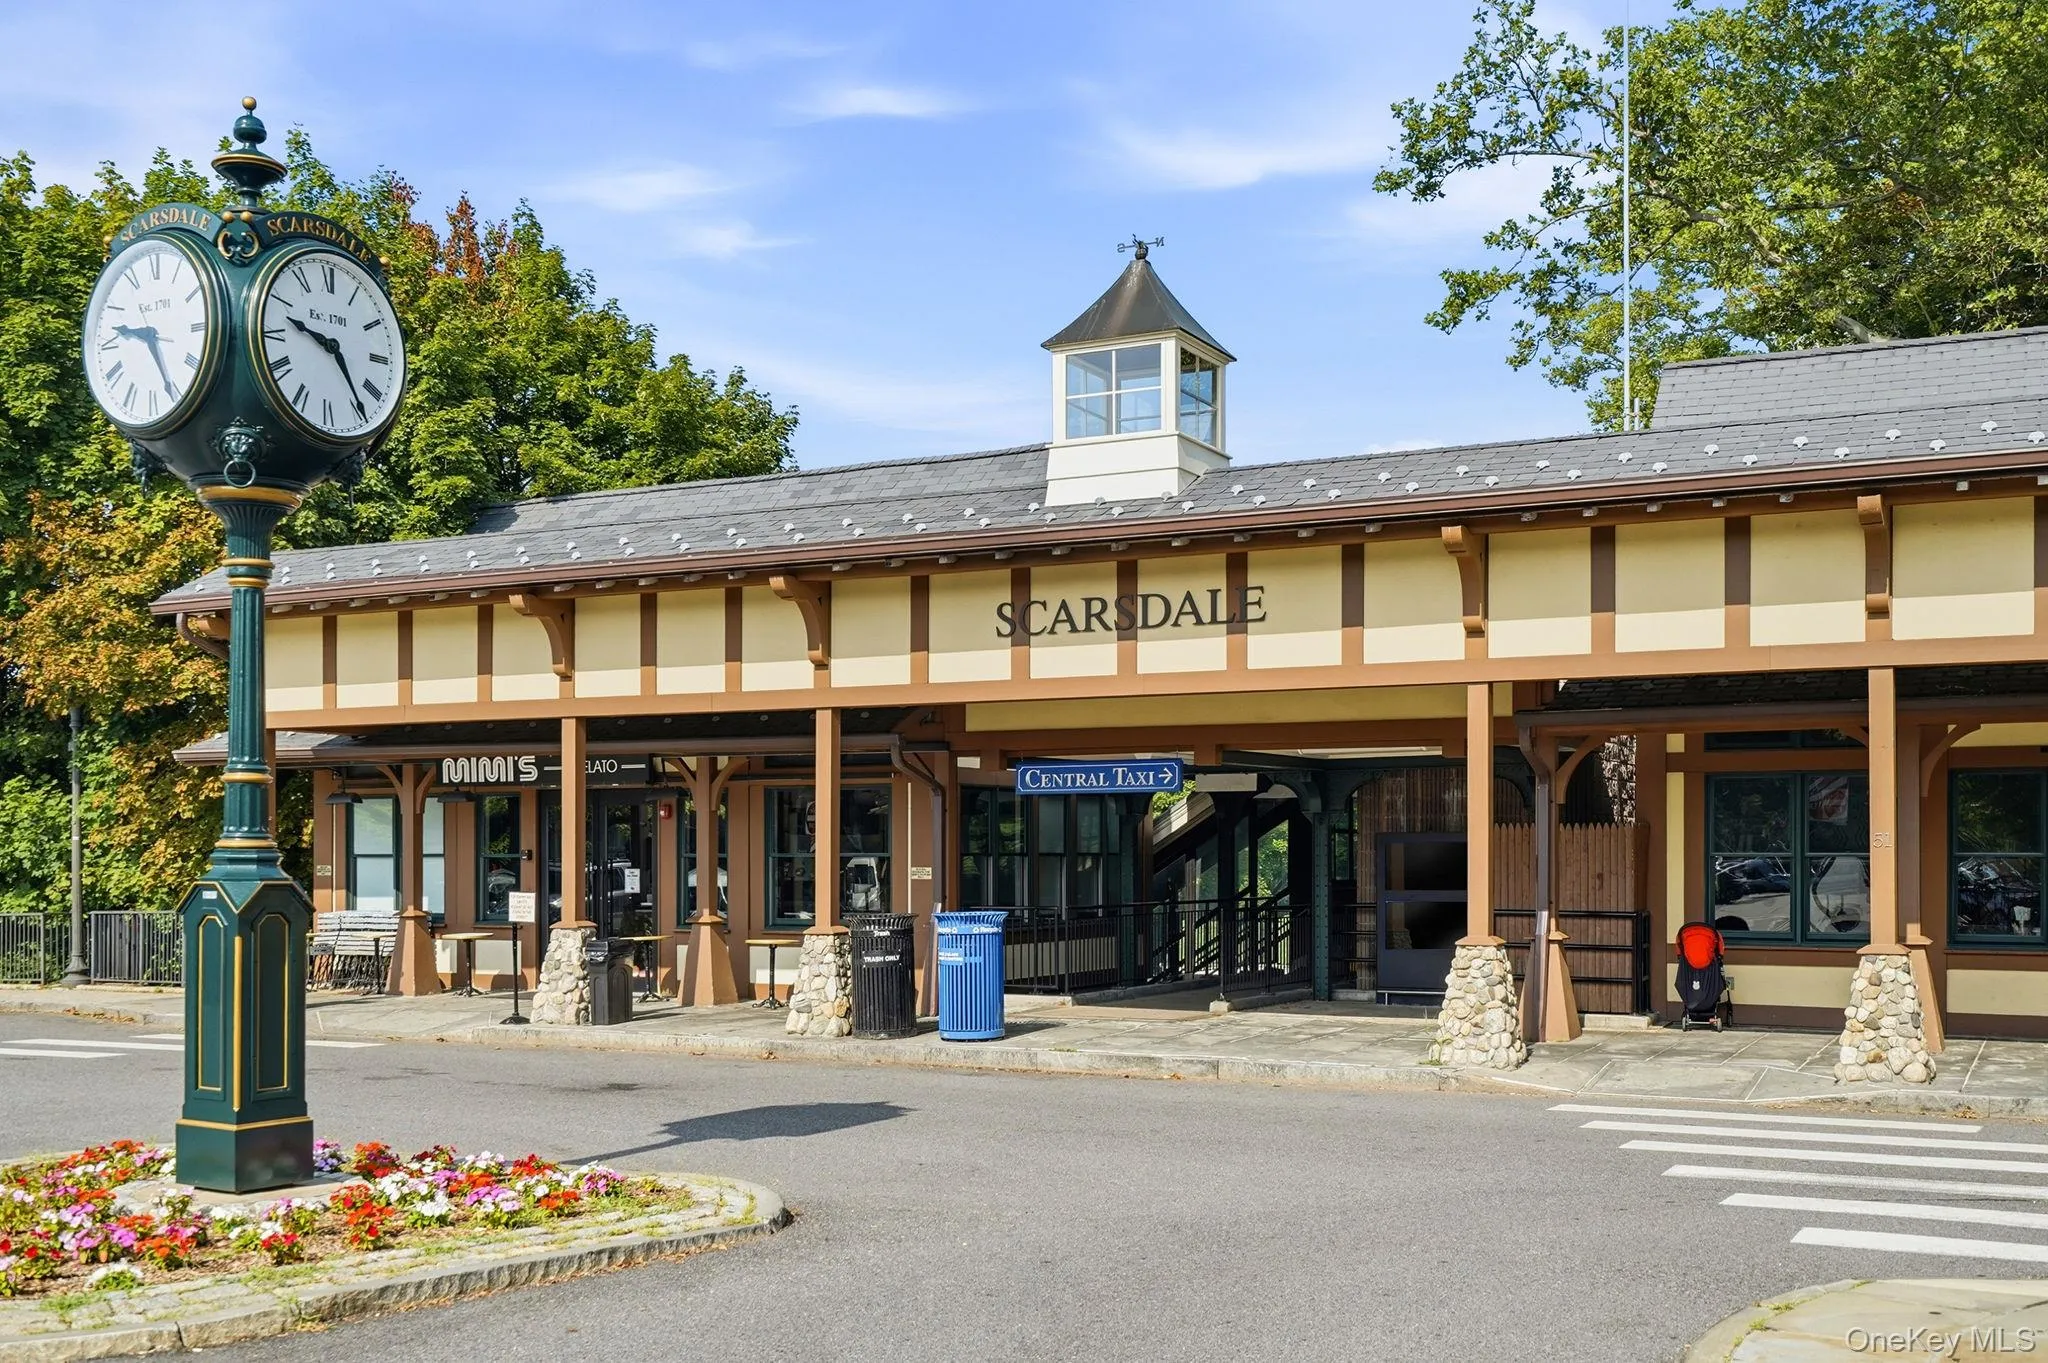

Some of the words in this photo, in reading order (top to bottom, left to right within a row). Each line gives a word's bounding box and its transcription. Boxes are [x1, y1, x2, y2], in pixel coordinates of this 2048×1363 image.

[121, 207, 212, 246] SCARSDALE
[267, 216, 372, 264] SCARSDALE
[154, 298, 171, 312] 1701
[329, 313, 347, 328] 1701
[995, 585, 1267, 638] SCARSDALE
[442, 755, 539, 784] MIMI'S
[1025, 768, 1109, 788] CENTRAL
[1113, 767, 1155, 787] TAXI
[873, 930, 890, 938] Trash
[884, 954, 900, 962] ONLY
